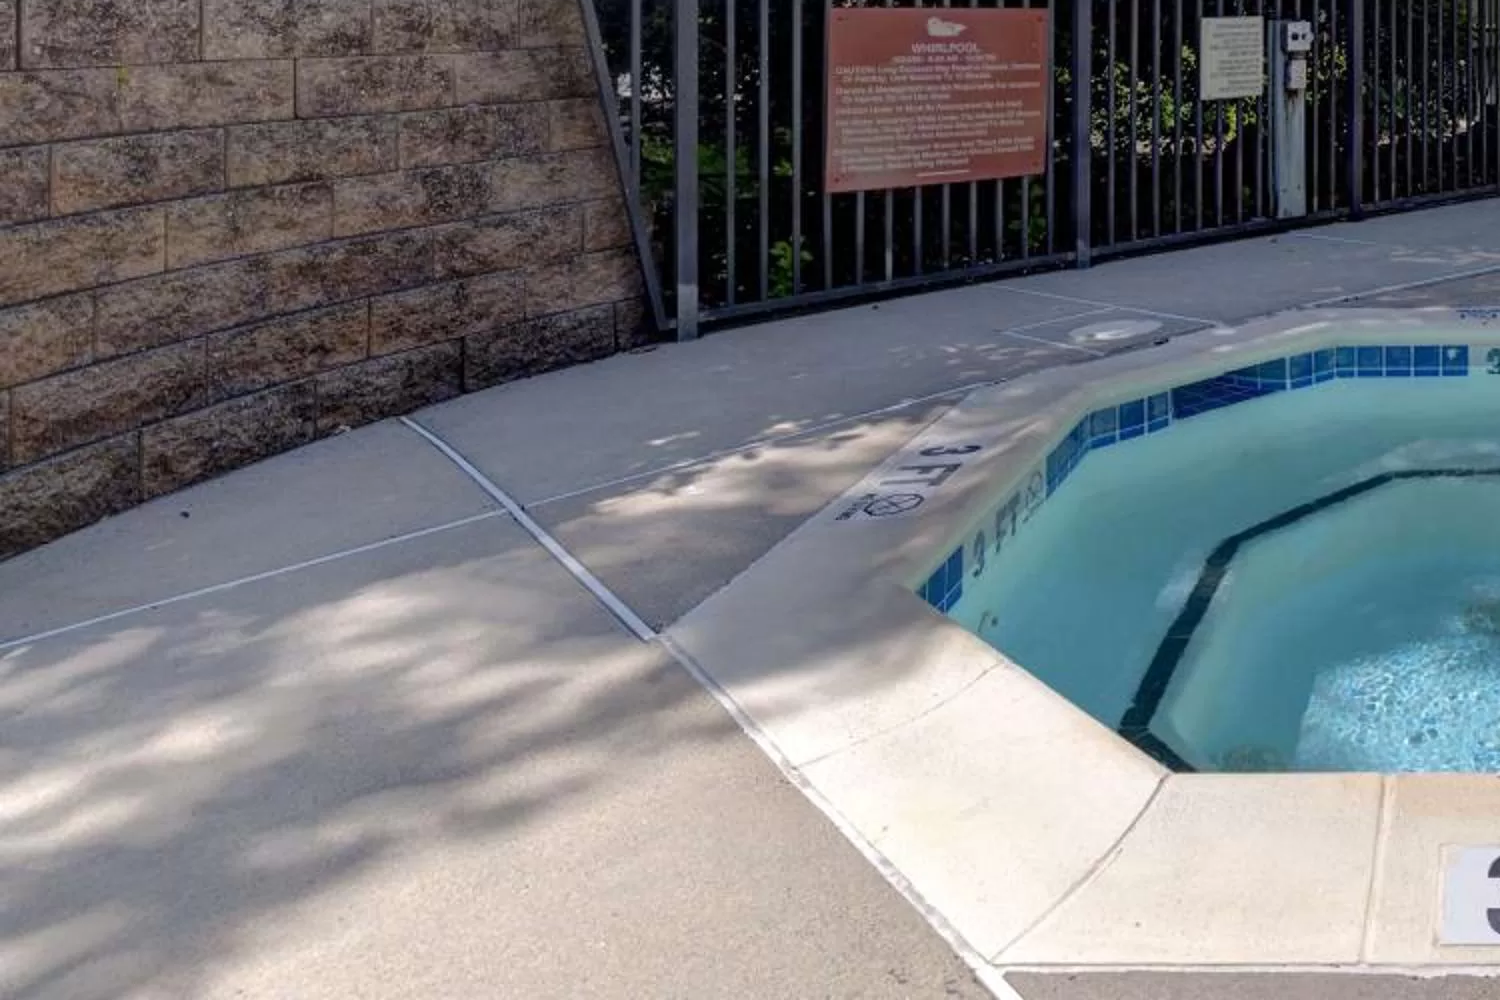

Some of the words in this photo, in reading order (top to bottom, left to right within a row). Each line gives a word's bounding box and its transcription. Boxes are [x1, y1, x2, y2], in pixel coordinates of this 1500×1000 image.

[919, 445, 982, 456] 3
[879, 462, 962, 487] FT
[972, 529, 985, 578] 3
[995, 490, 1021, 553] FT
